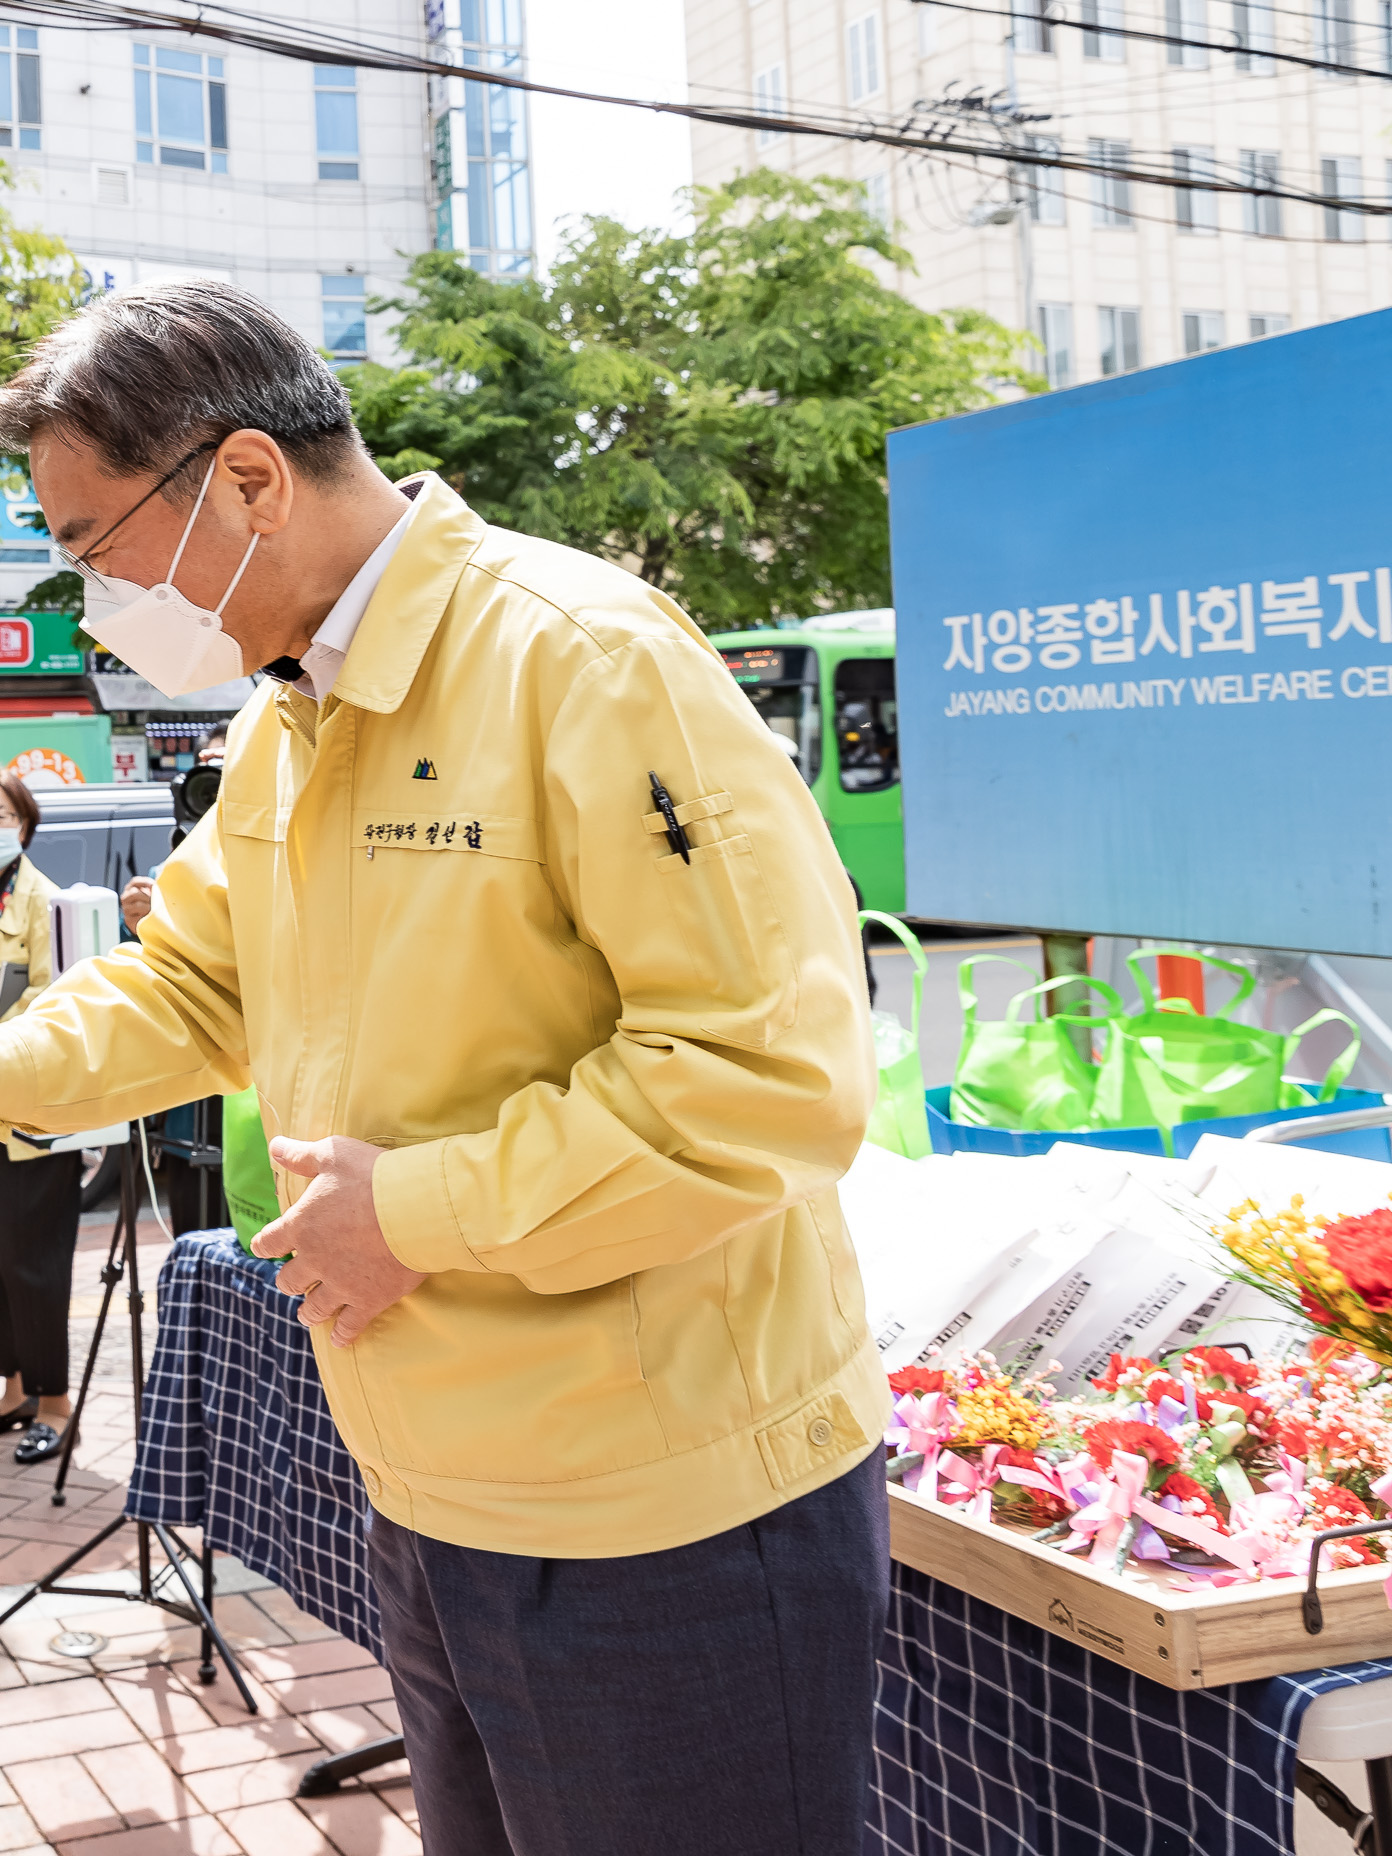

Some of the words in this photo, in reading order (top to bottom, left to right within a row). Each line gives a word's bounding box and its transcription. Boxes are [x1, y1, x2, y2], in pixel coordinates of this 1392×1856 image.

[942, 566, 1392, 675] 자양종합사회복지
[944, 687, 1031, 718] JAYANG
[1034, 678, 1186, 713] COMMUNITY
[1191, 669, 1334, 705] WELFARE
[1340, 664, 1392, 699] CE
